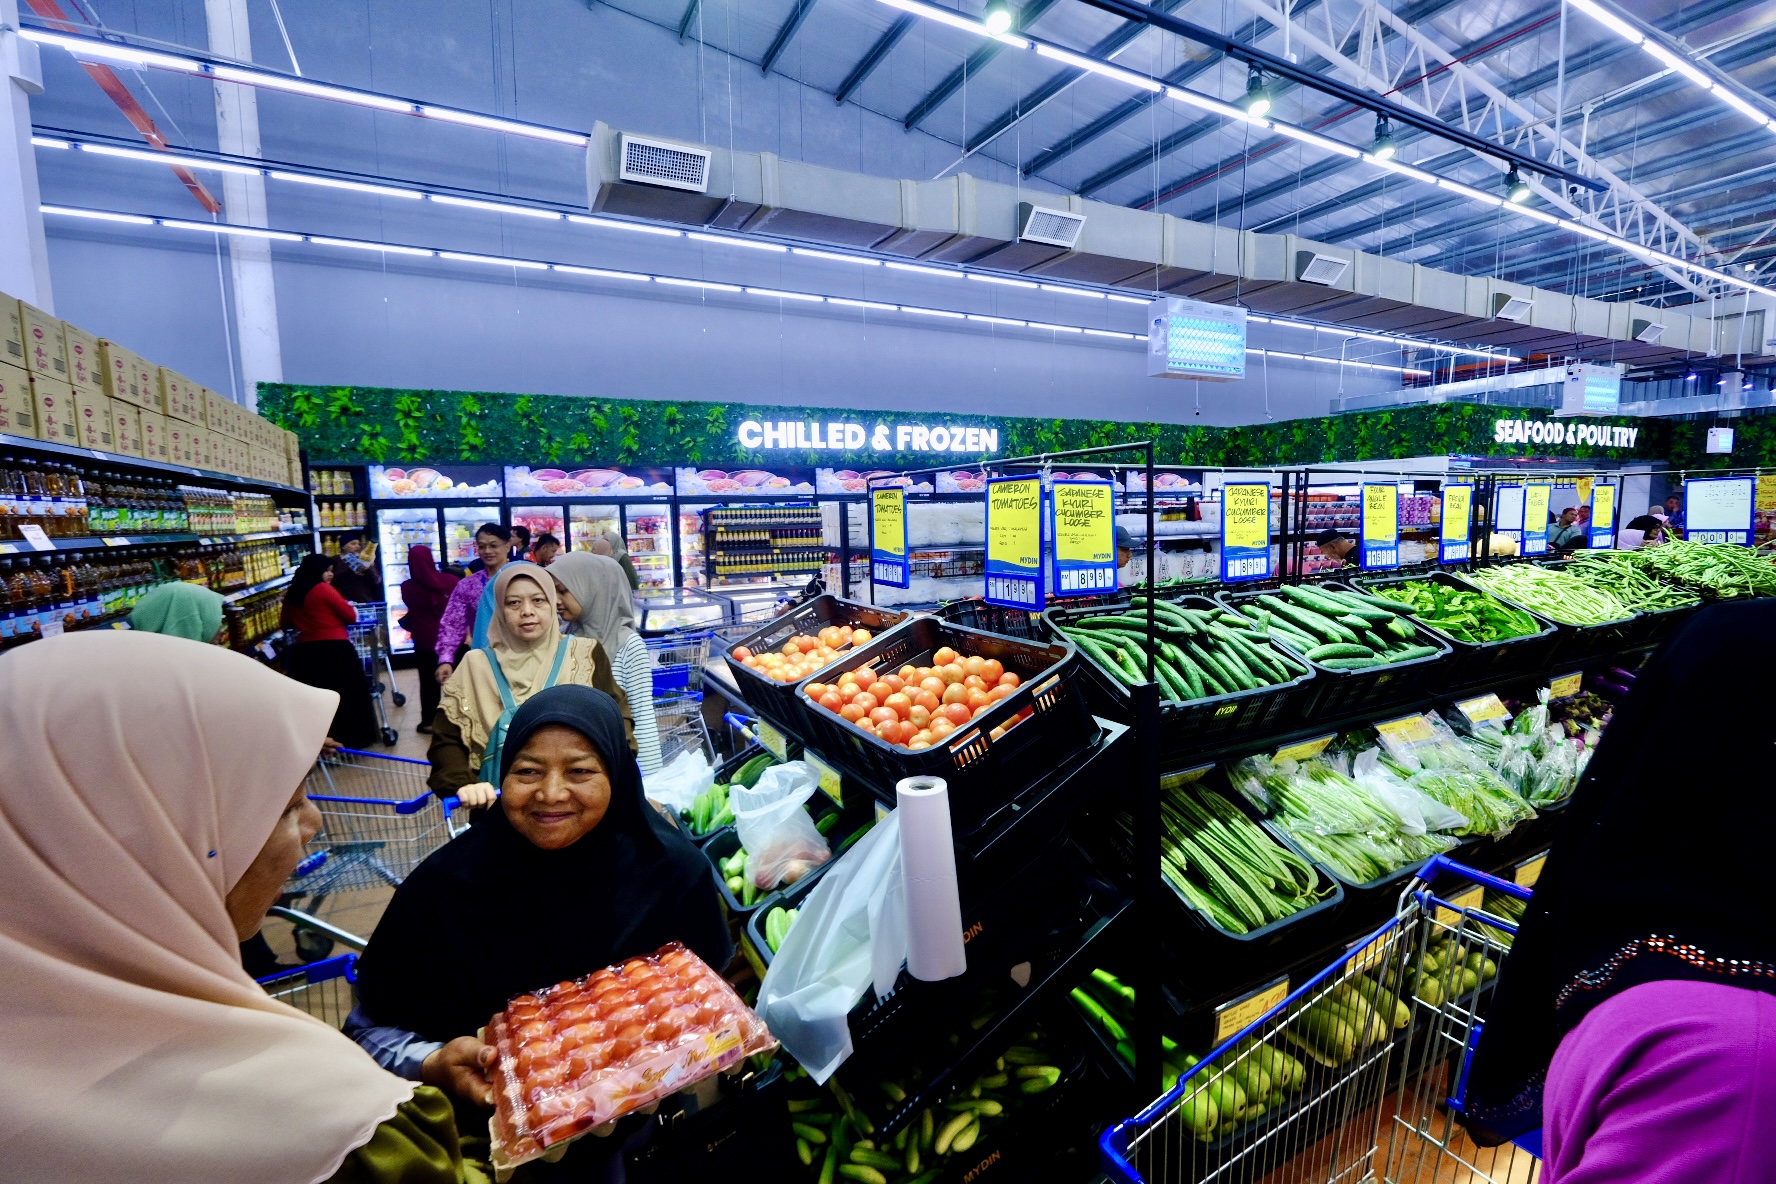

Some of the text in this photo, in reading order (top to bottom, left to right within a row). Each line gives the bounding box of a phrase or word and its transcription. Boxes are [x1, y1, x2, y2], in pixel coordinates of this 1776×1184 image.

[738, 421, 999, 452] CHILLED & FROZEN
[1494, 419, 1639, 449] SEAFOOD & POULTRY
[992, 483, 1031, 495] CAMERON
[1057, 487, 1105, 499] JAPANESE
[1228, 487, 1265, 497] JAPANESE
[876, 492, 898, 501] CAMERON
[1234, 497, 1258, 506] KYURI
[991, 496, 1039, 510] TOMATOES
[1062, 498, 1094, 510] KYURI
[1369, 502, 1385, 510] BEAN
[874, 504, 902, 514] TOMATOES
[1055, 509, 1106, 519] CUCUMBER
[1226, 507, 1266, 517] CUCUMBER
[1063, 518, 1092, 528] LOOSE
[1233, 516, 1256, 524] LOOSE
[1019, 556, 1038, 565] MYDIN
[963, 920, 984, 945] DIN
[962, 1148, 1001, 1184] MYDIN
